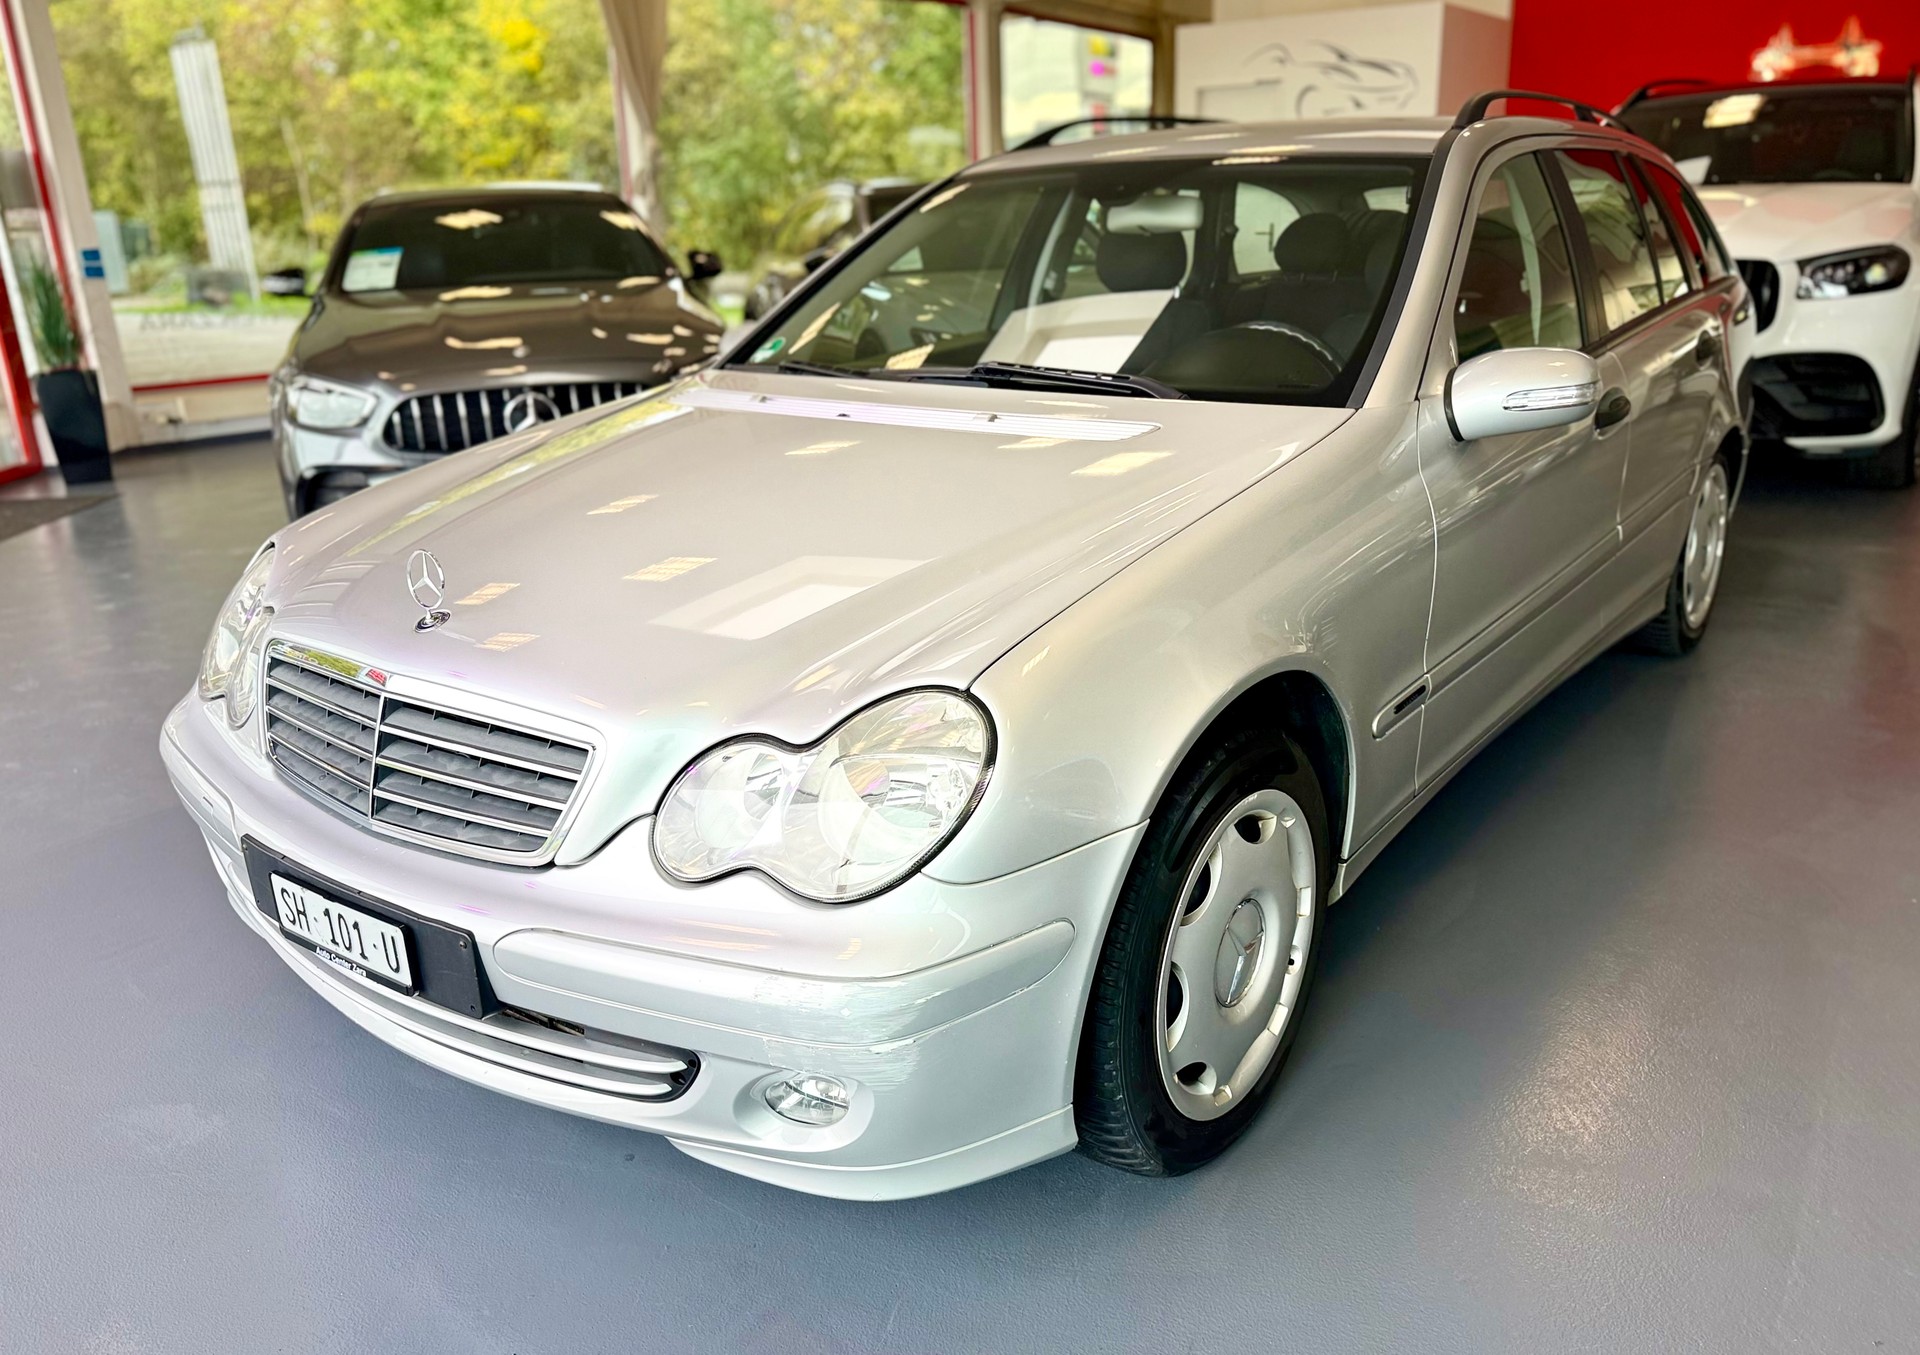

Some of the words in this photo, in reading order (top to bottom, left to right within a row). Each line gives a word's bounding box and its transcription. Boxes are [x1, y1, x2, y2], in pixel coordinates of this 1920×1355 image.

[280, 887, 311, 933] SH
[322, 907, 370, 962] 101
[380, 931, 401, 974] U
[315, 945, 331, 961] Auto
[330, 953, 352, 971] Center
